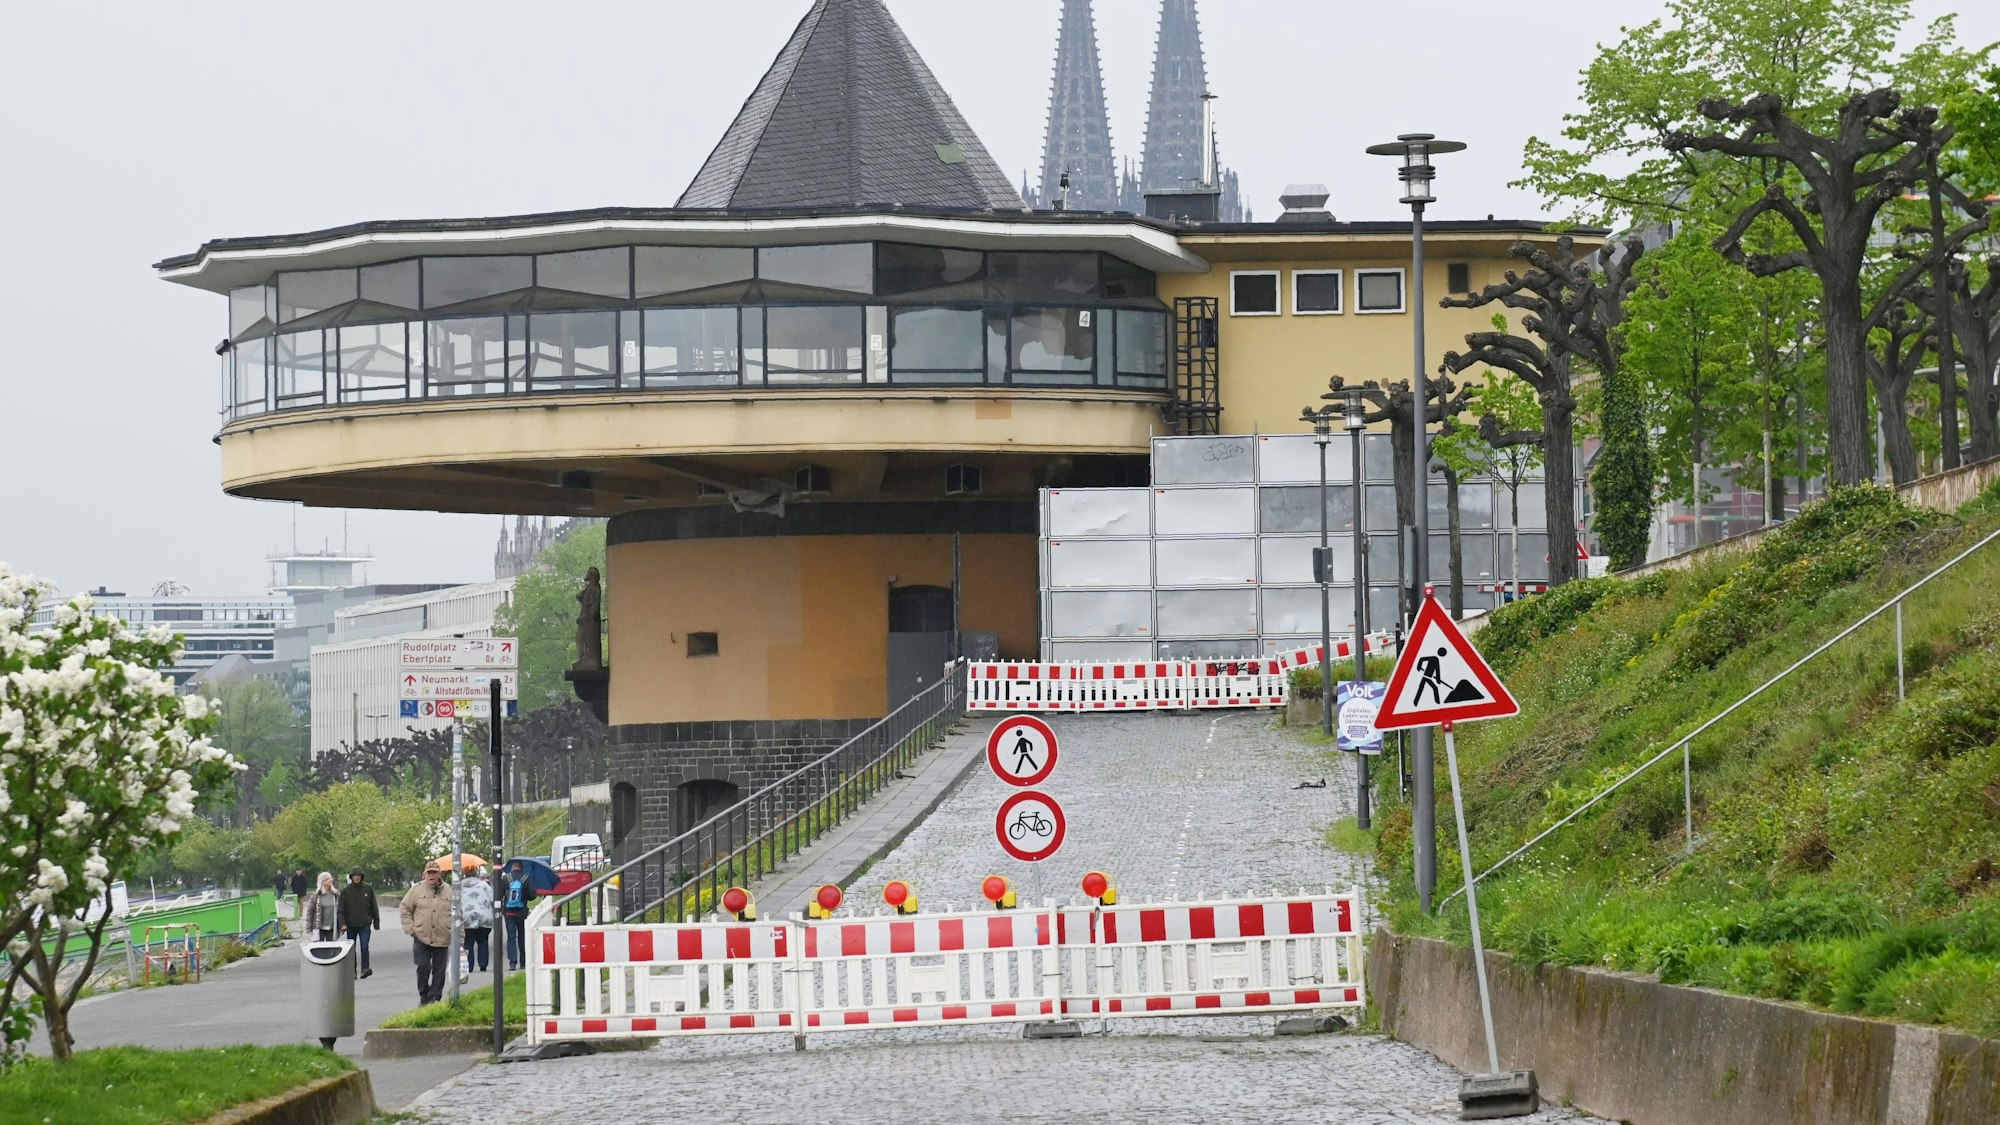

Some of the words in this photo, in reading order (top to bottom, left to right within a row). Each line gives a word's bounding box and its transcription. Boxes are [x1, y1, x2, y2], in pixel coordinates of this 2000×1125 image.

[1080, 312, 1088, 326] 4
[873, 336, 880, 349] 5
[626, 342, 633, 355] 6
[403, 642, 457, 653] Rudolfplatz
[403, 654, 452, 664] Ebertplatz
[421, 675, 469, 684] Neumarkt
[435, 686, 491, 696] Altstadt/Dom/H
[1346, 684, 1375, 698] Volt
[474, 704, 480, 712] R
